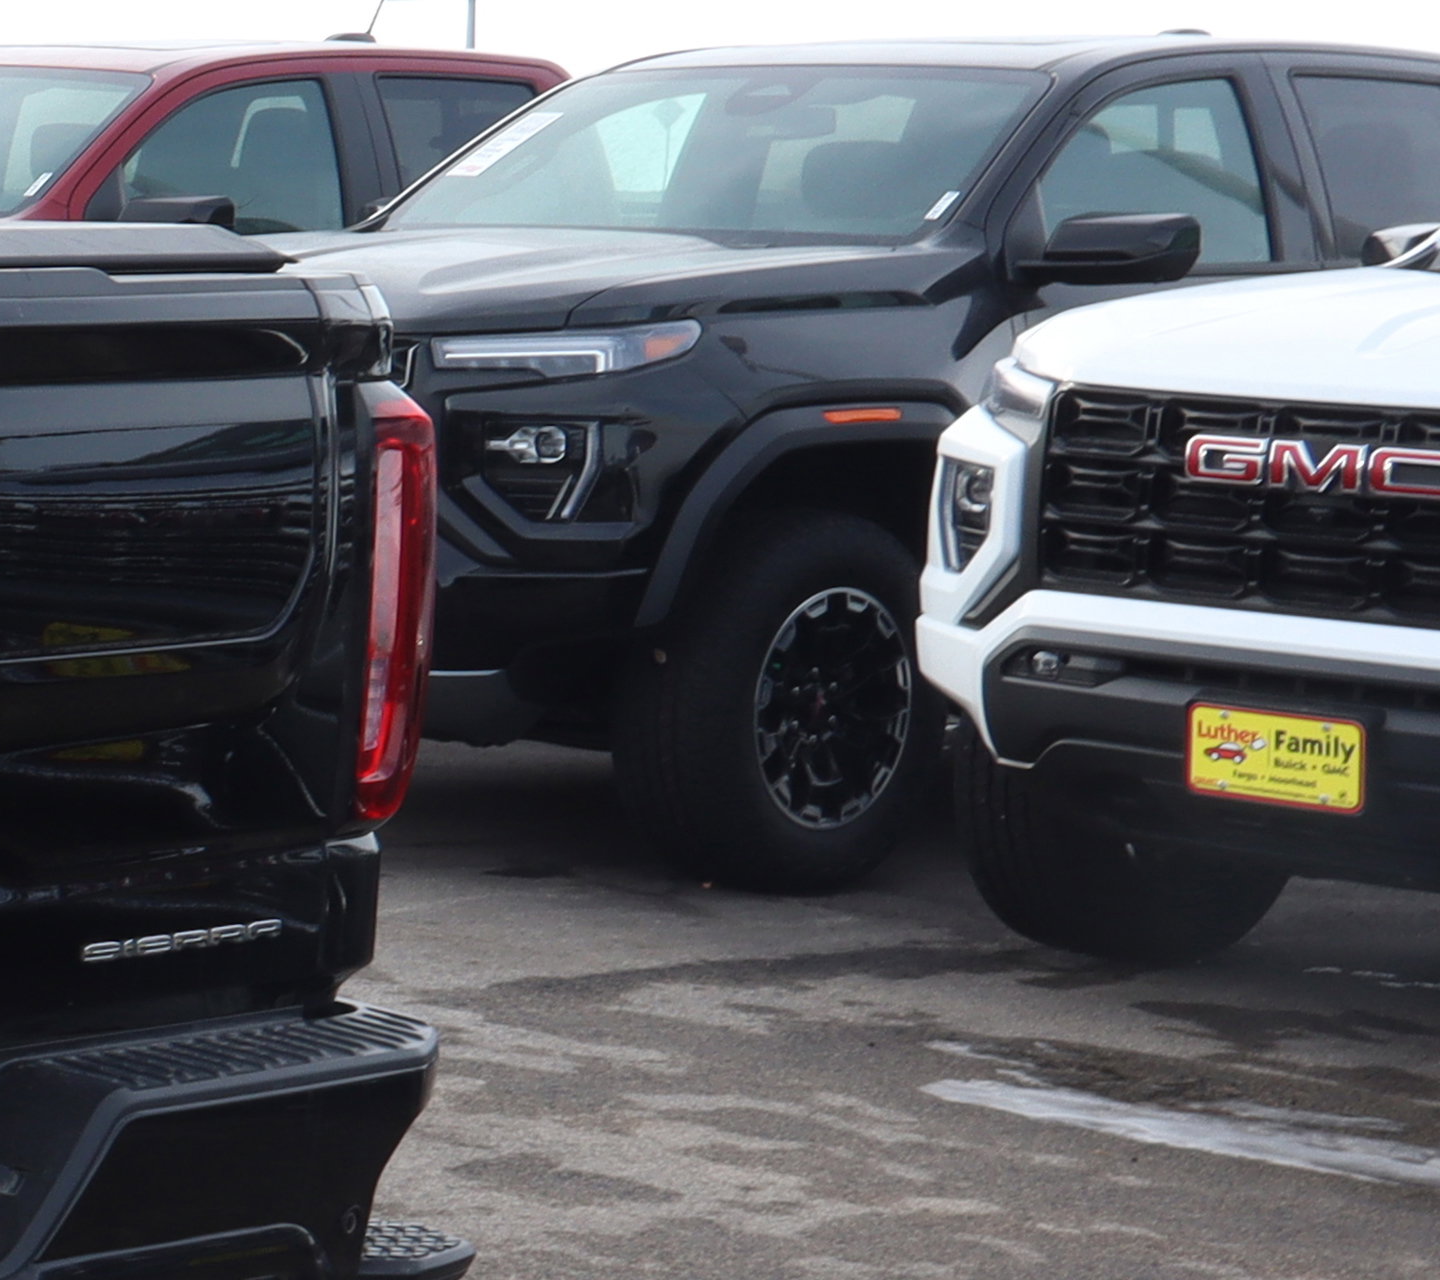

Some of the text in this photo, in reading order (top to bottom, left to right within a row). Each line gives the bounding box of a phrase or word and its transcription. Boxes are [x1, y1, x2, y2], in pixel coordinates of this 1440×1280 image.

[1185, 434, 1440, 499] GMC
[1197, 720, 1260, 744] Luther
[1274, 729, 1356, 764] Family
[82, 918, 282, 963] SIERRA
